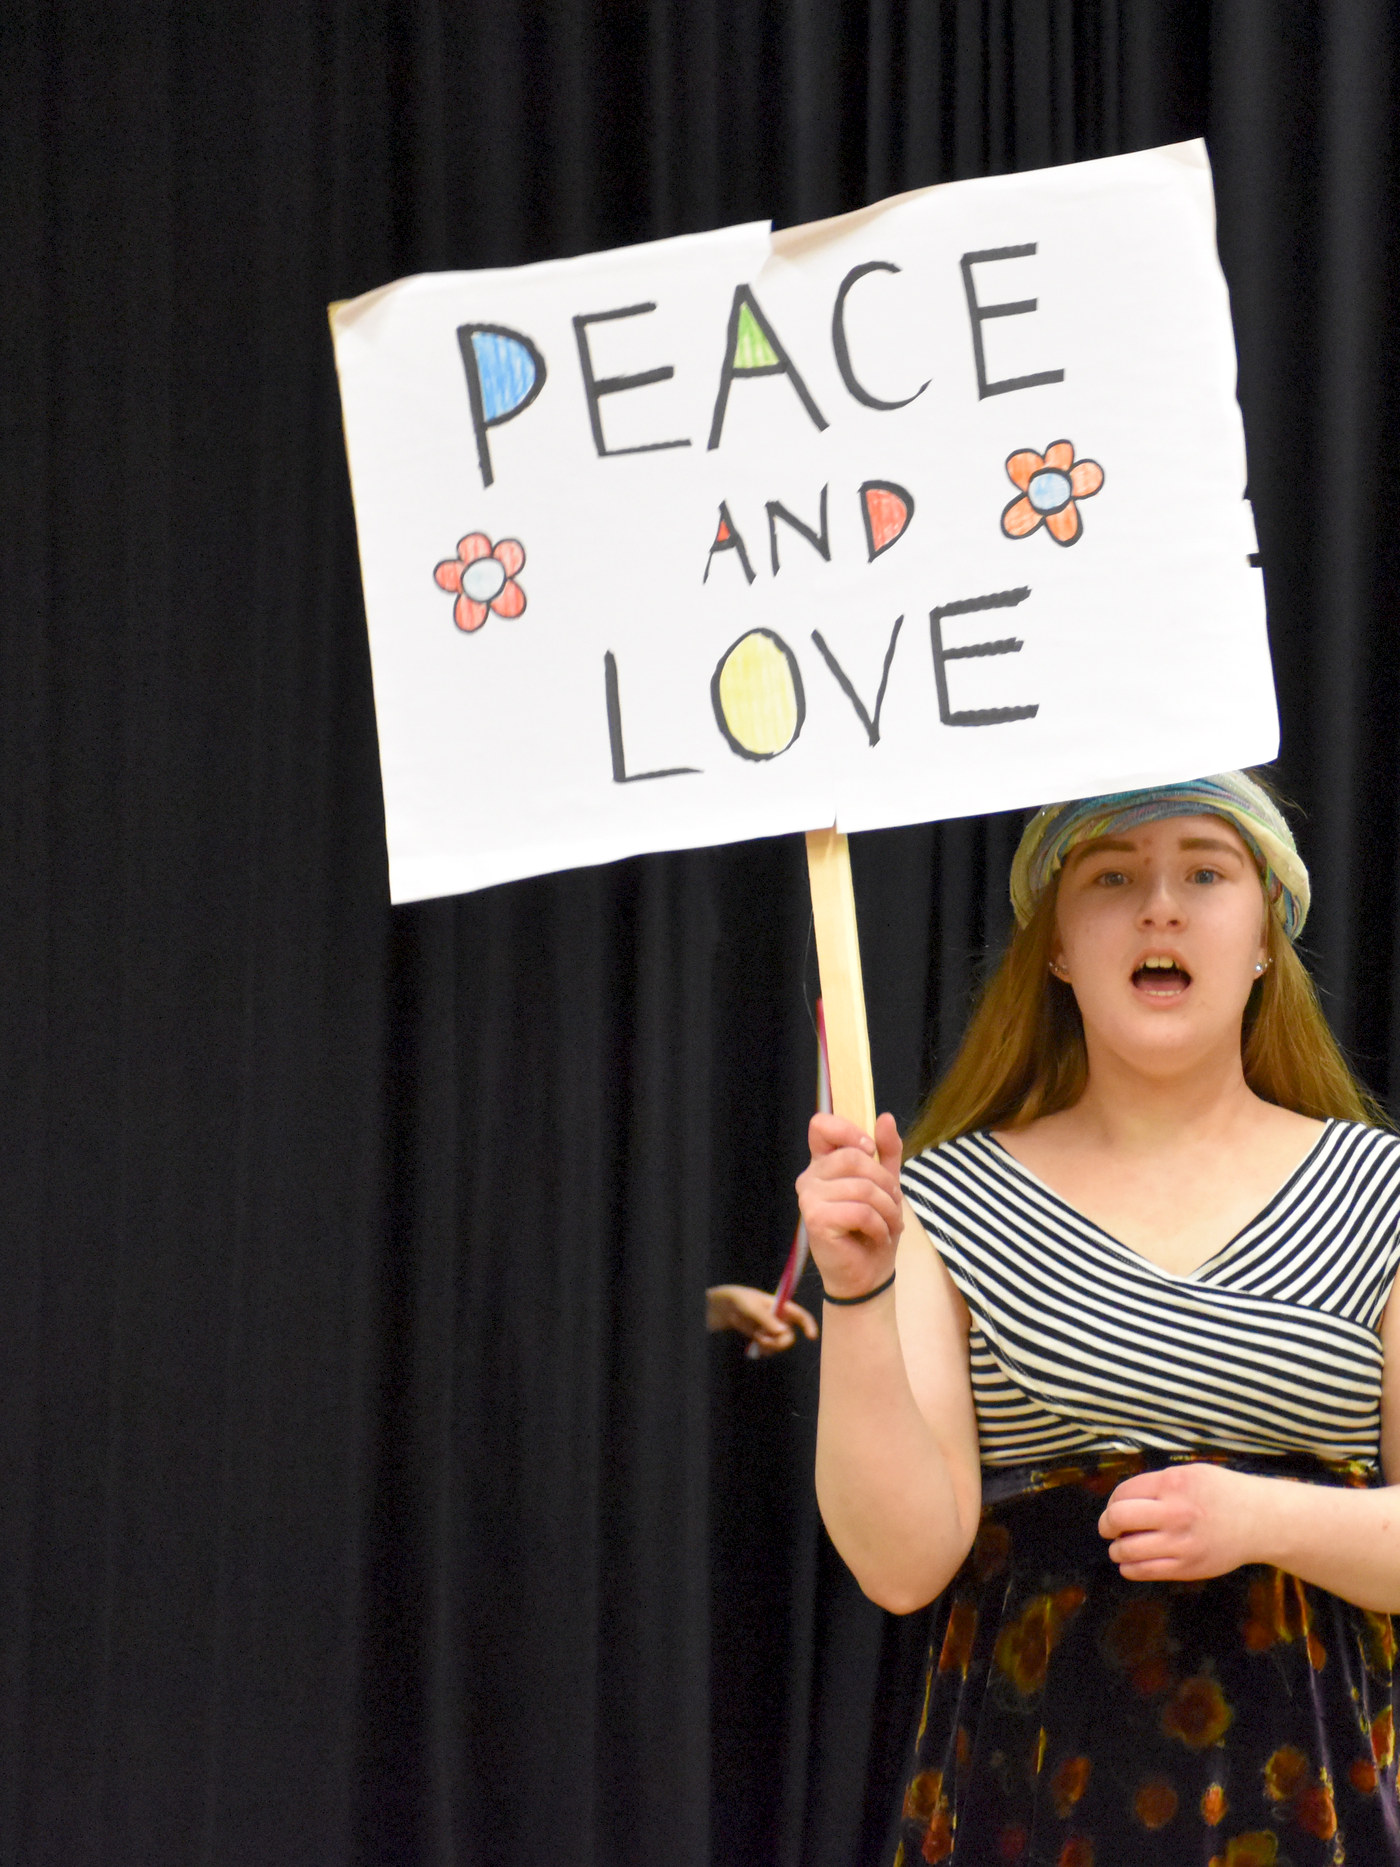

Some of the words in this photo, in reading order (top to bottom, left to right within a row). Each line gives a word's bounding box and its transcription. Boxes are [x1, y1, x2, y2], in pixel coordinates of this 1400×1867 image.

[457, 242, 1065, 488] PEACE
[703, 480, 916, 585] AND
[604, 586, 1039, 783] LOVE
